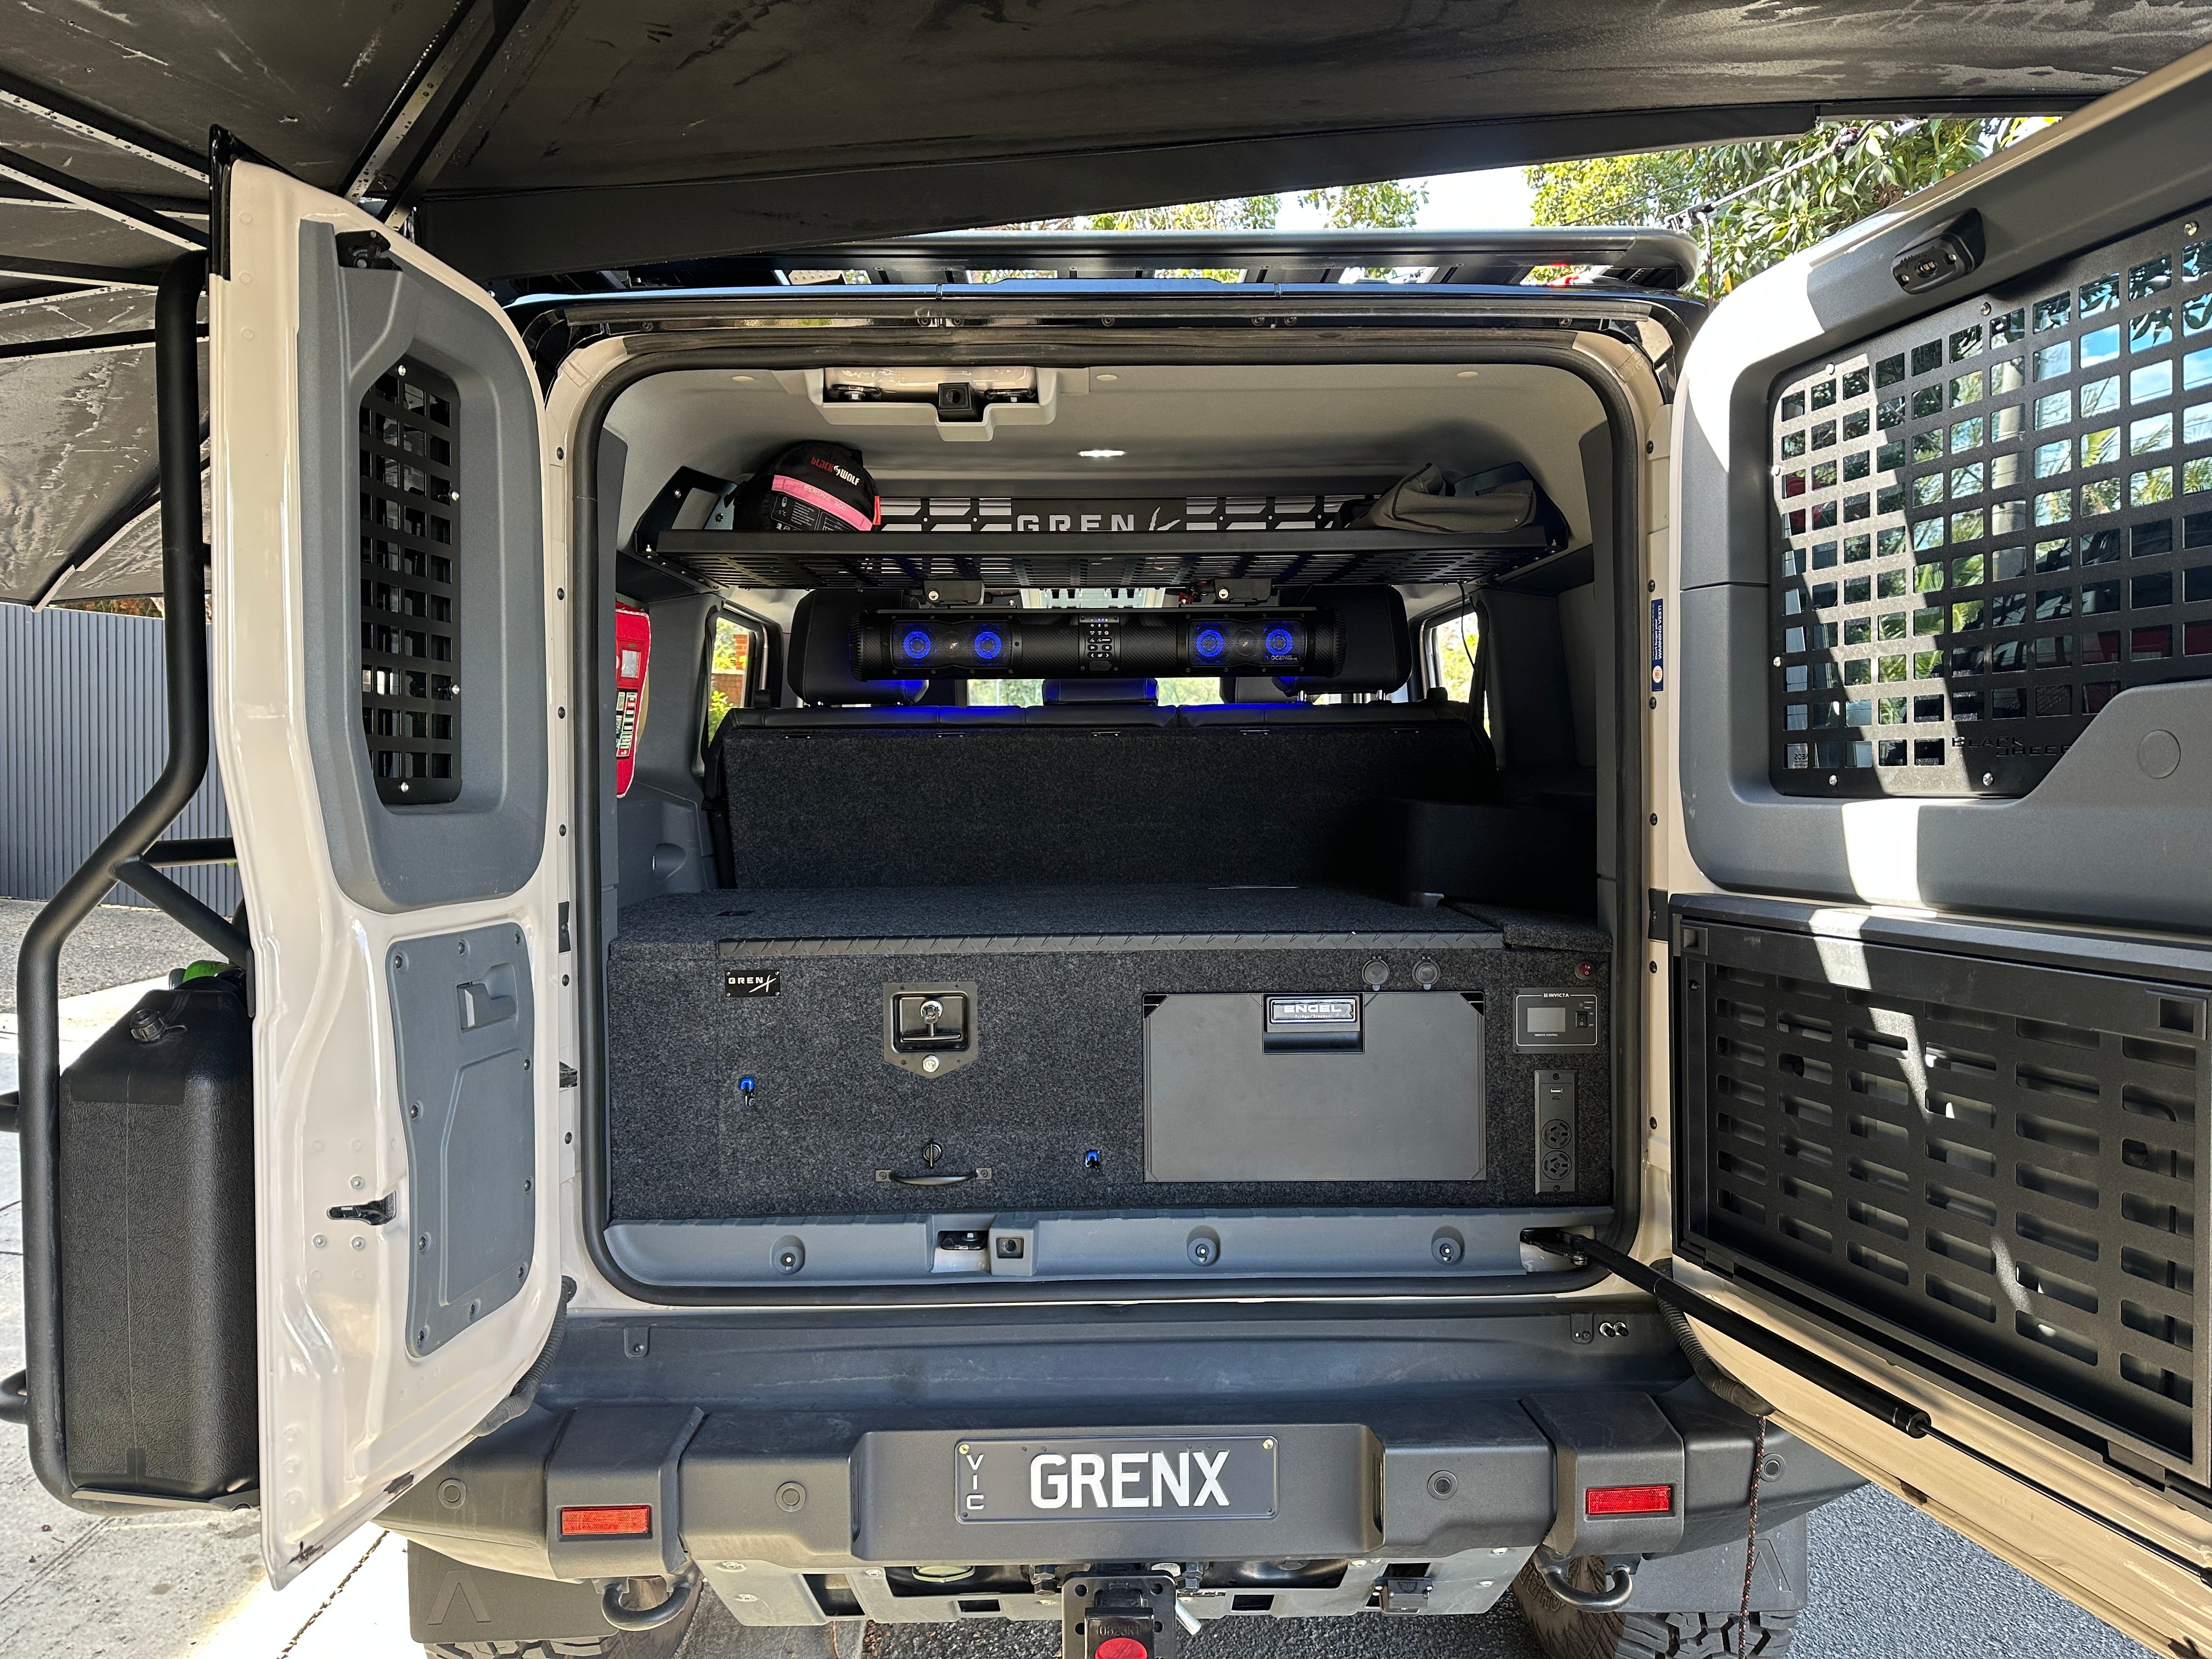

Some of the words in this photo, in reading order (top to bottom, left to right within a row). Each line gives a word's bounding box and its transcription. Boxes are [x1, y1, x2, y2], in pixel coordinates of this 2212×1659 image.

[839, 469, 860, 486] WOLF
[1284, 1005, 1342, 1013] ENGEL
[966, 1454, 984, 1510] VIC
[1030, 1451, 1231, 1509] GRENX
